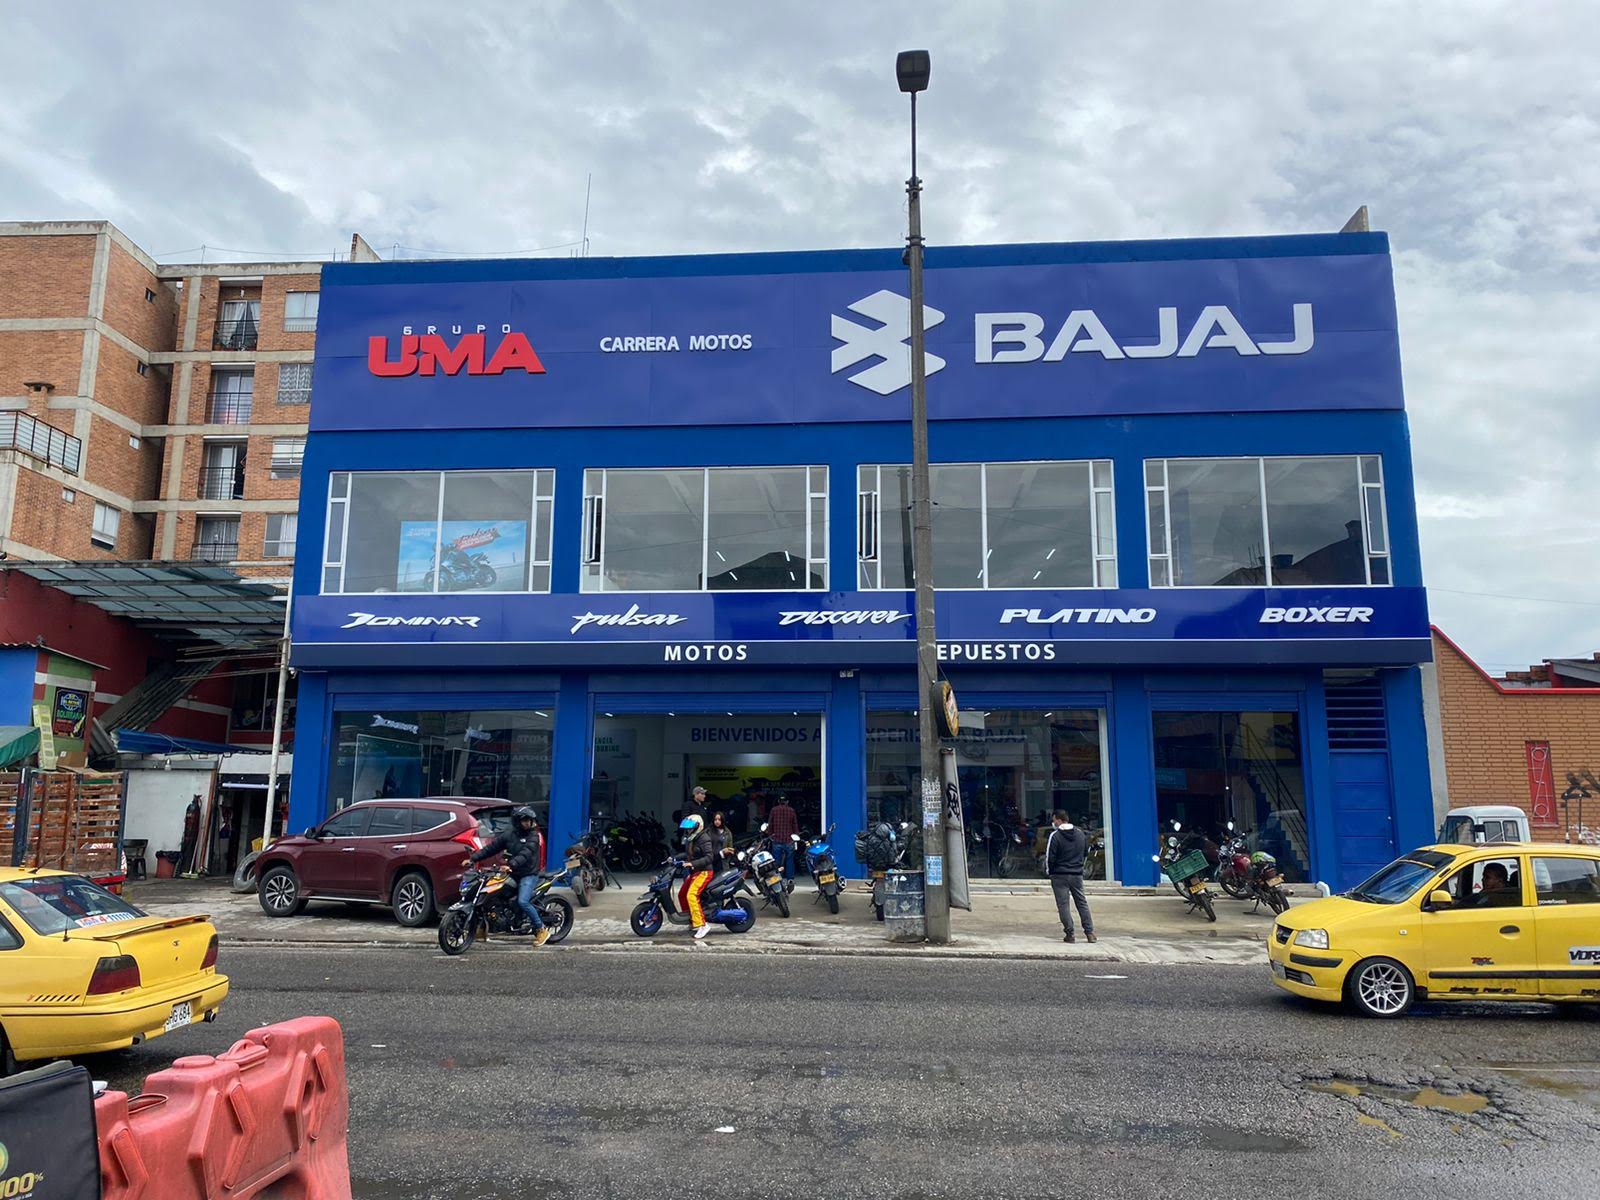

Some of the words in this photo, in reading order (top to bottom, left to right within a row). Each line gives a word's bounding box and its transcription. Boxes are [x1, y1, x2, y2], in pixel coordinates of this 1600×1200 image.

[402, 323, 512, 336] GRUPO
[974, 302, 1315, 364] BAJAJ
[599, 336, 681, 352] CARRERA
[689, 334, 753, 351] MOTOS
[367, 332, 547, 378] UMA
[340, 611, 482, 629] DOMINAR
[999, 607, 1158, 625] PLATINO
[1258, 606, 1375, 624] BOXER
[663, 643, 749, 662] MOTOS
[935, 642, 1057, 662] EPUESTOS
[690, 727, 808, 743] BIENVENIDOS
